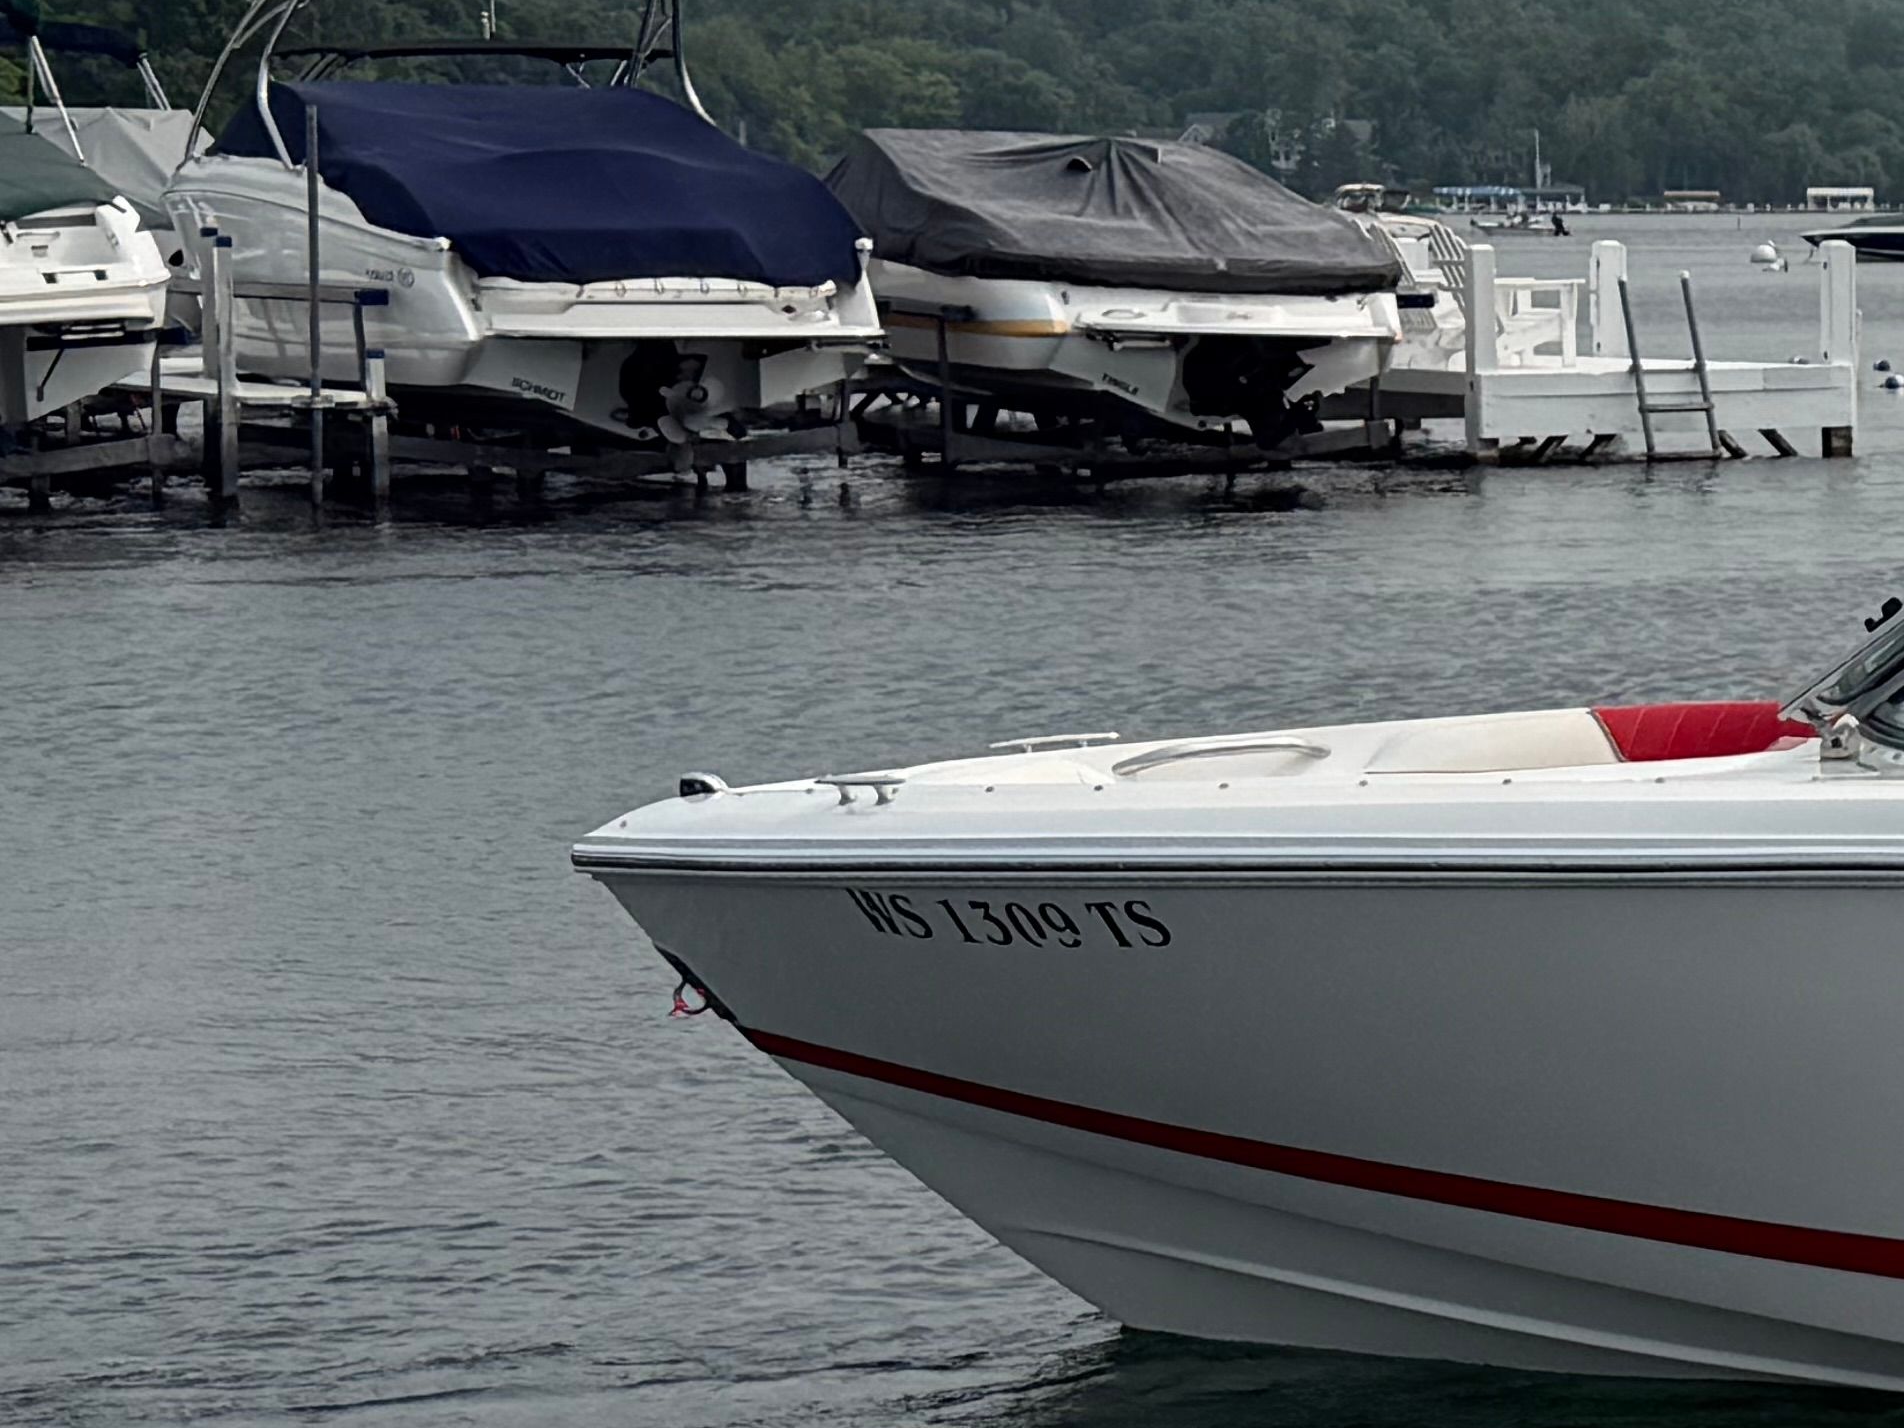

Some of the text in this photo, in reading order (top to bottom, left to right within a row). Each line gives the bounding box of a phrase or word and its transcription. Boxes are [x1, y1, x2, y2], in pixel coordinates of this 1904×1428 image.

[845, 887, 1172, 948] WS 1309 TS
